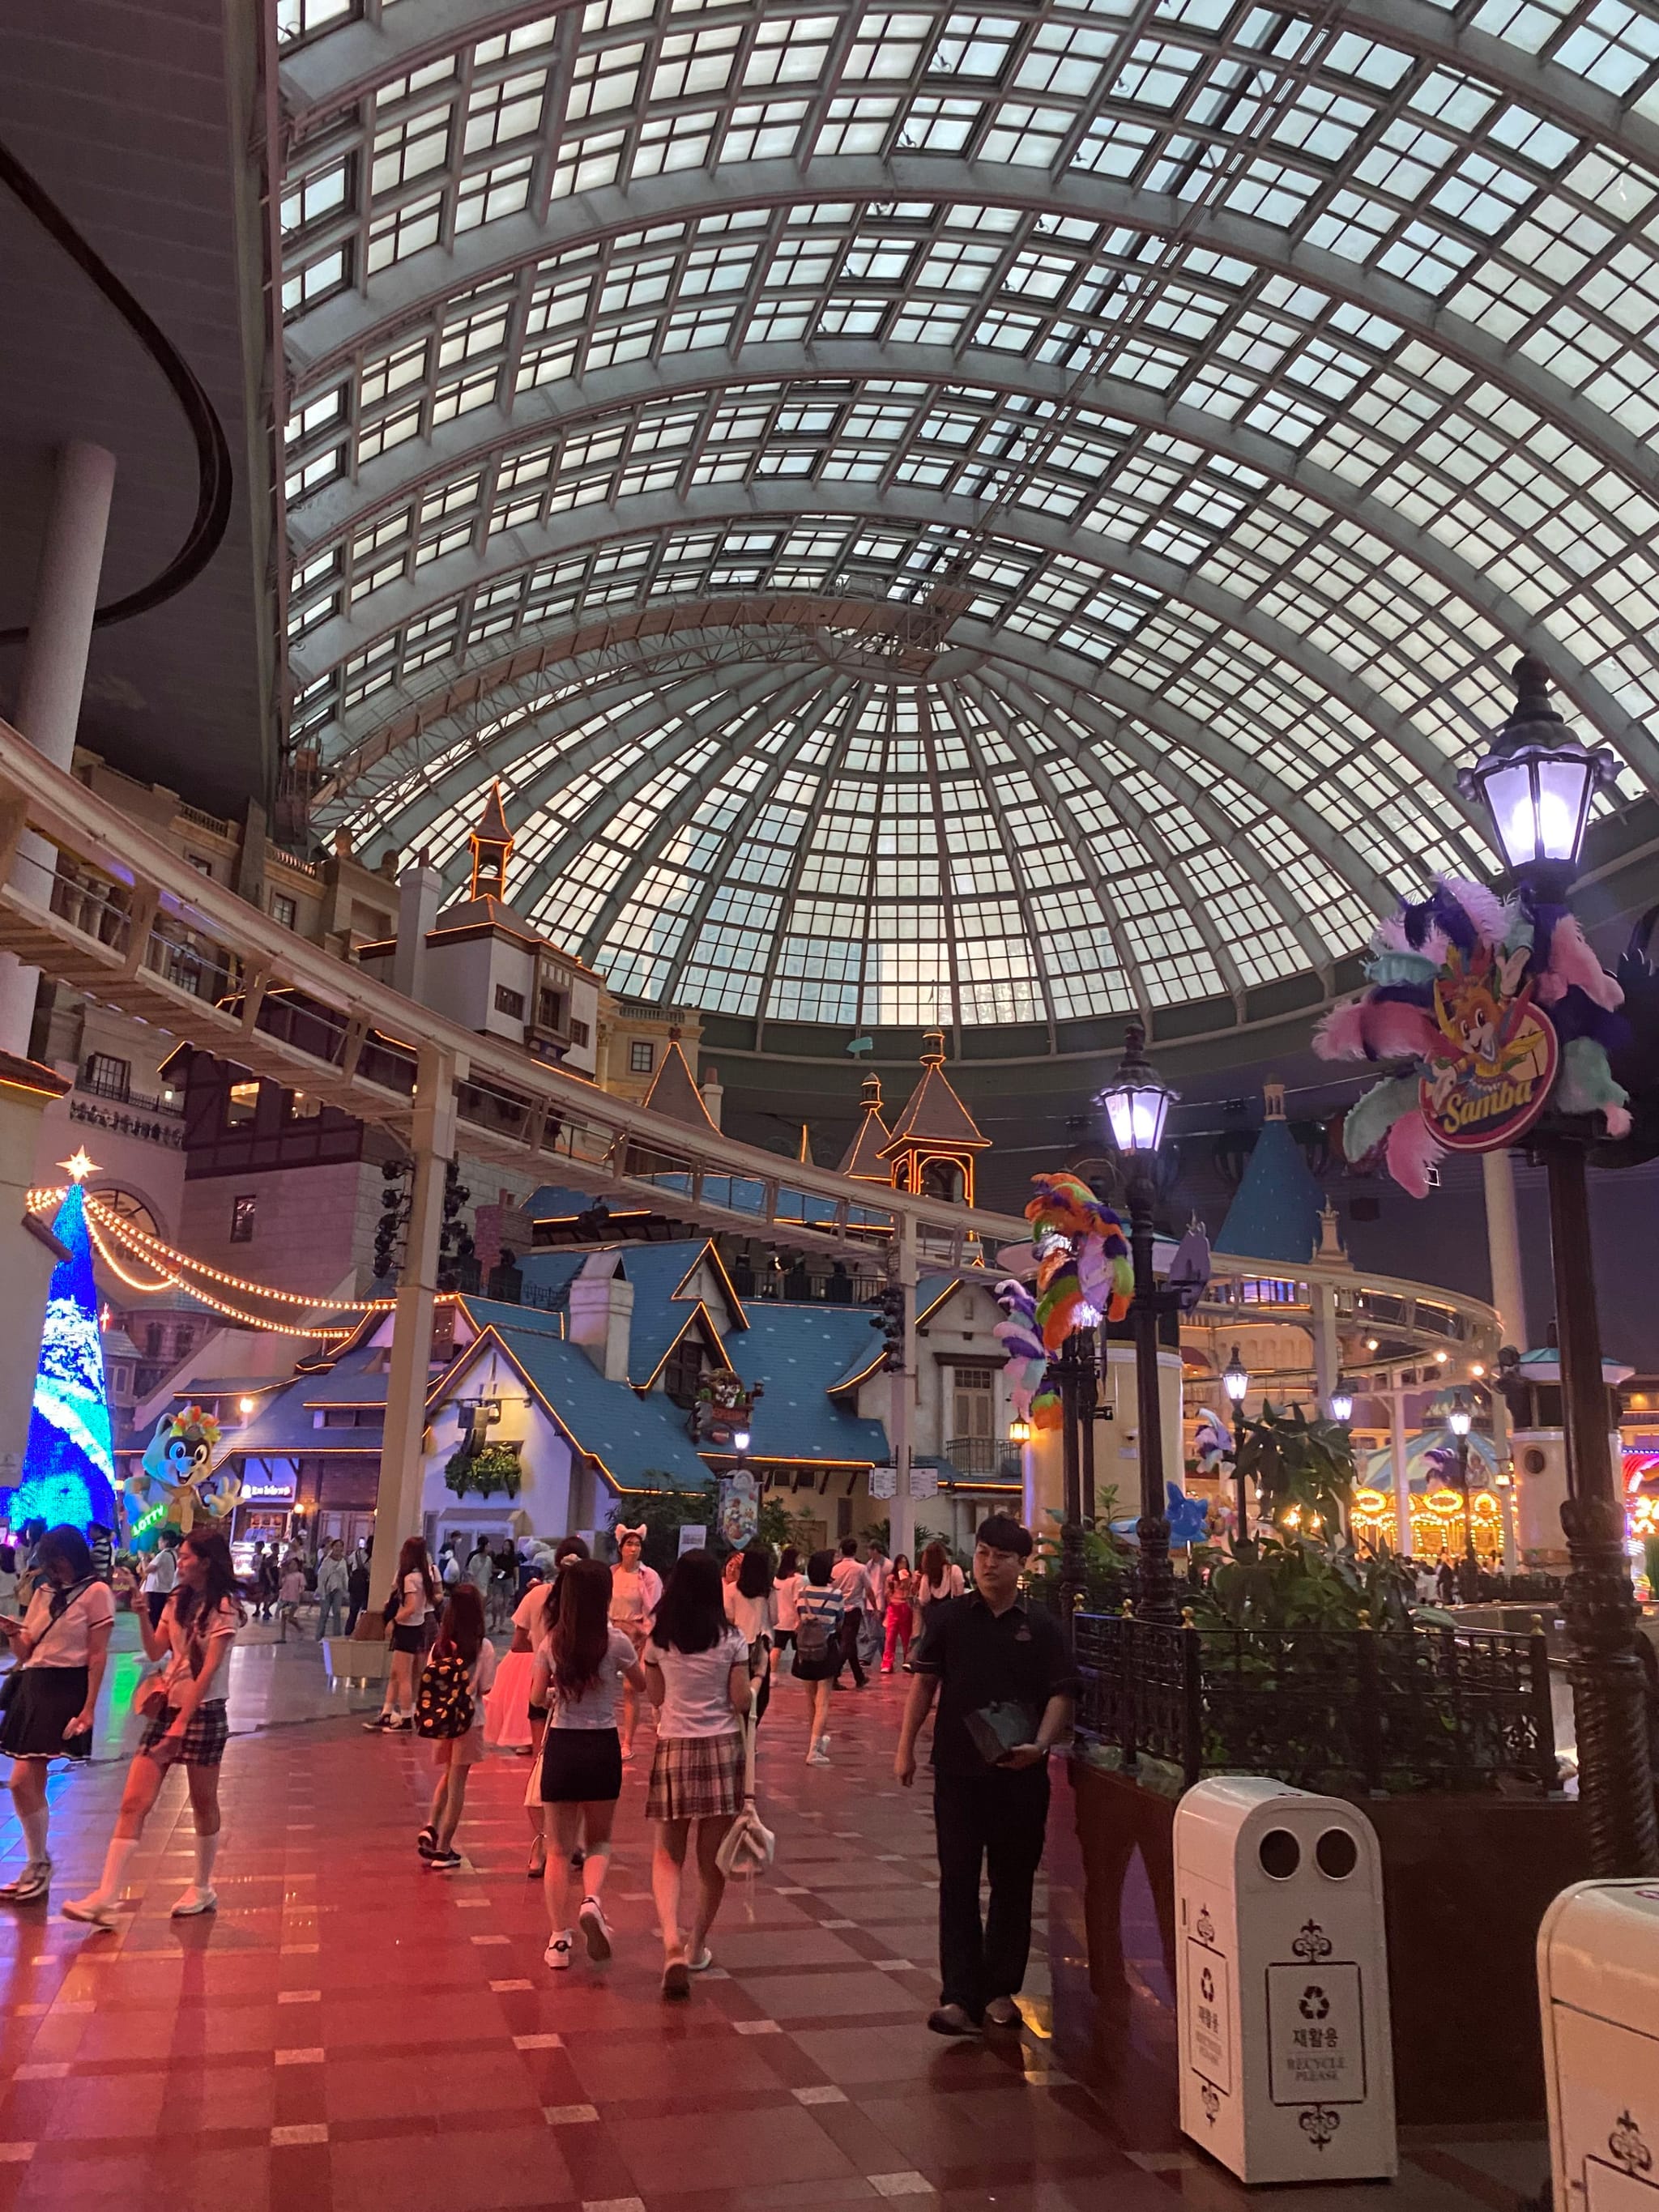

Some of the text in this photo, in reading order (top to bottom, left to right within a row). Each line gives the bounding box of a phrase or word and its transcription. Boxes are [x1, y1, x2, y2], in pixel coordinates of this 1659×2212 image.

[1444, 1080, 1533, 1133] Samba
[133, 1505, 164, 1536] LOTTY
[1292, 2027, 1338, 2048] 재활용
